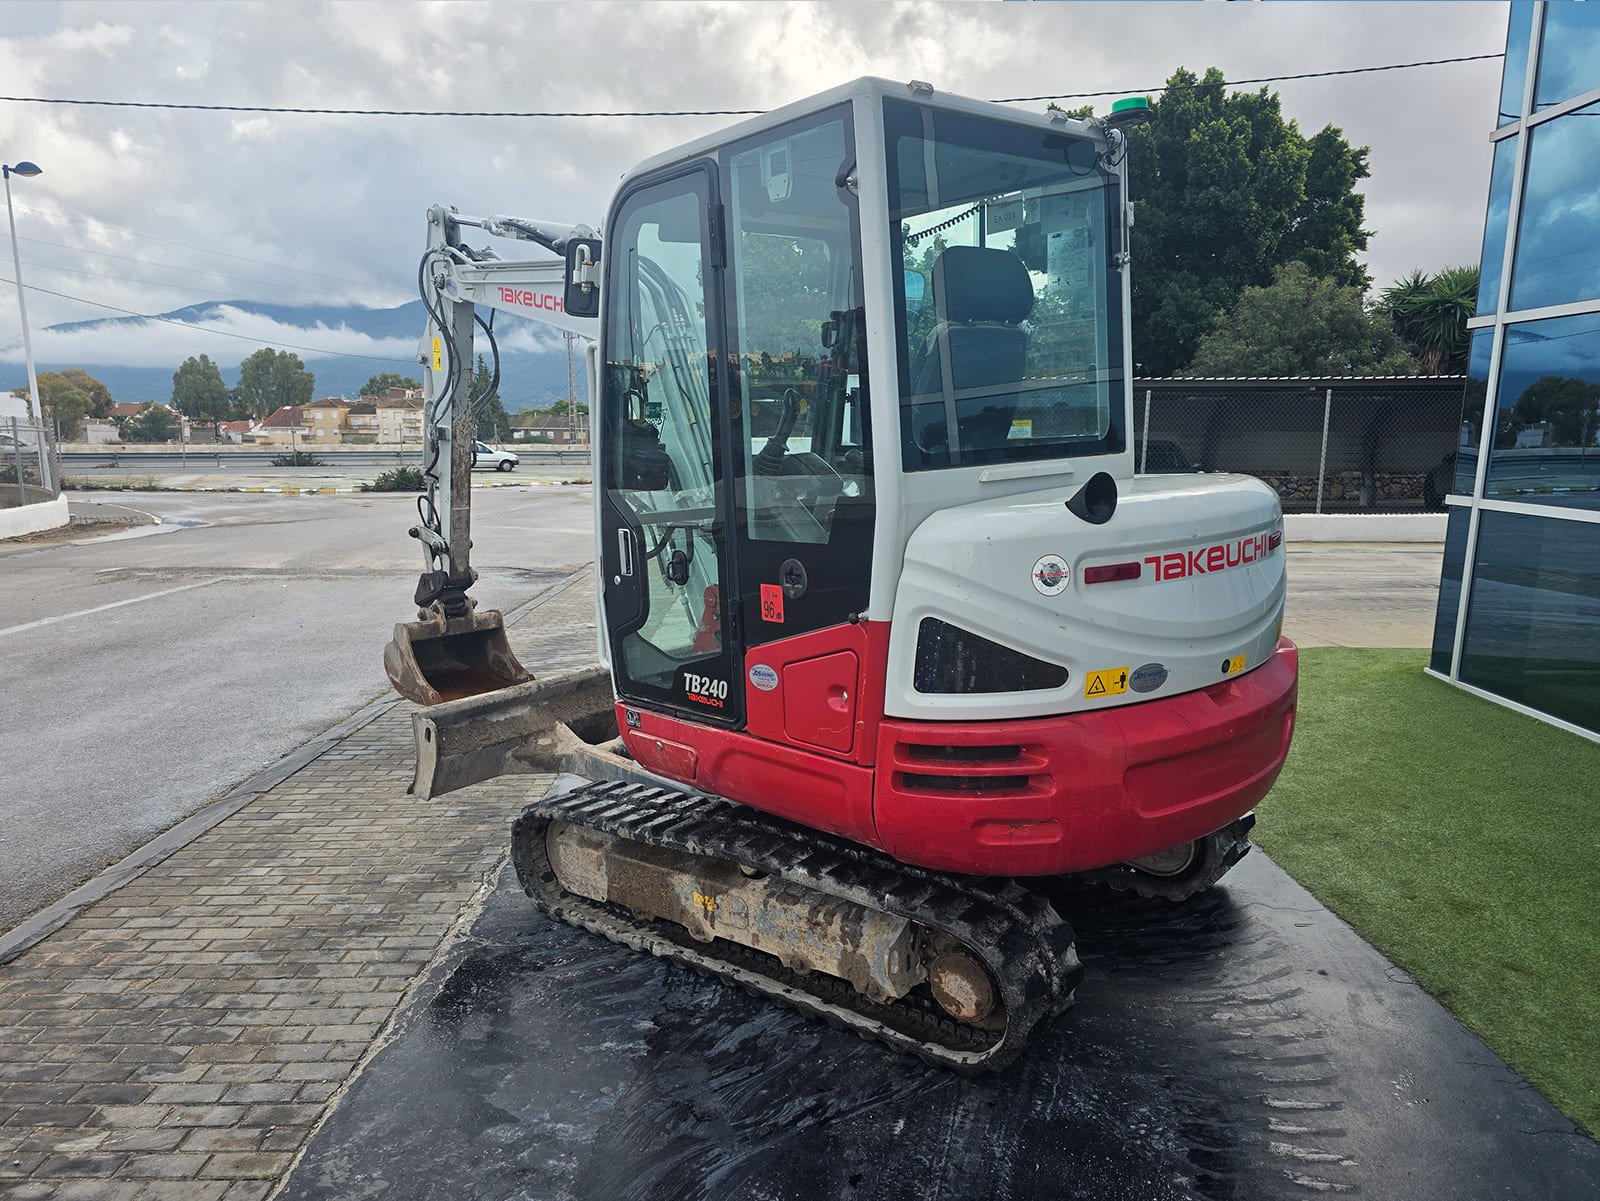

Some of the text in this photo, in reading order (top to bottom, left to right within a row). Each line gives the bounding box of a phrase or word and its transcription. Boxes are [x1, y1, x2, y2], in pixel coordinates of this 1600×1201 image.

[497, 286, 564, 313] TAKEUCH
[1144, 533, 1267, 582] TAKEUCHI
[763, 600, 775, 618] 96
[683, 672, 728, 700] TB240
